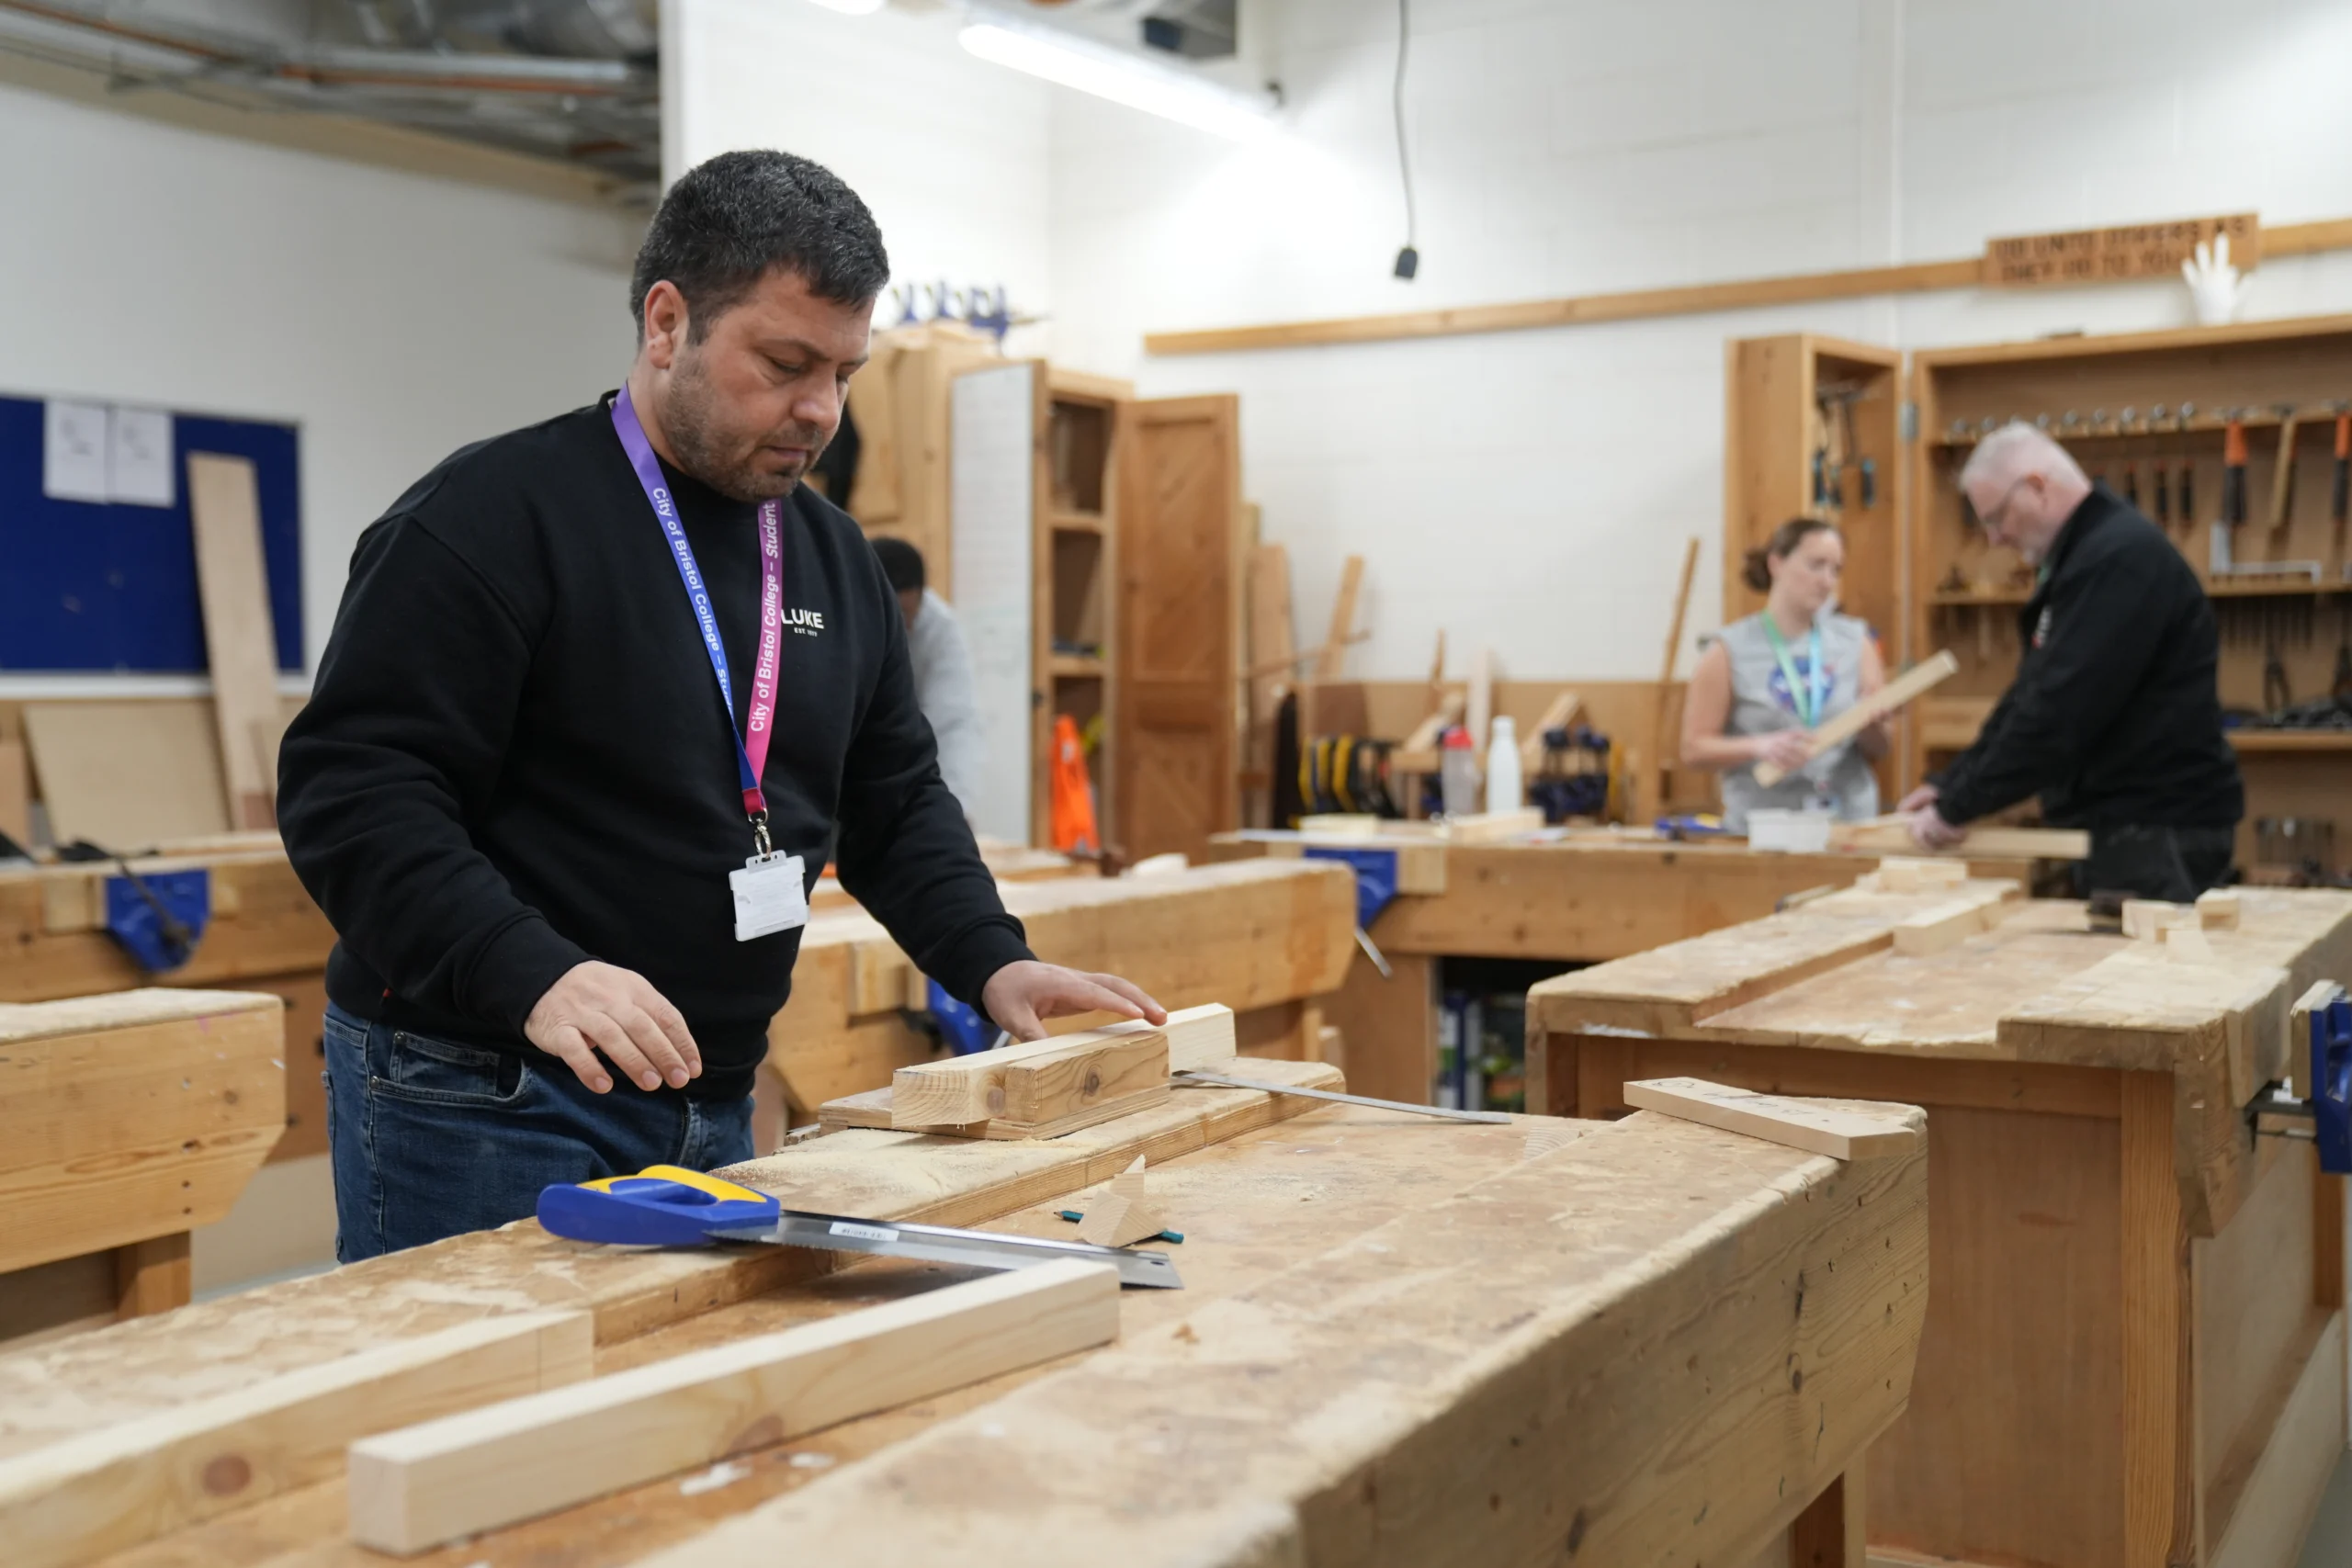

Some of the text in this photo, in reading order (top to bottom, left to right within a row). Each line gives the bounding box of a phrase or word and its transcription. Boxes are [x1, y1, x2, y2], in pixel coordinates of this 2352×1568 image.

[653, 488, 673, 517] City
[667, 521, 682, 536] of
[763, 503, 778, 558] Student
[674, 539, 702, 590] Bristol
[764, 574, 778, 626] College
[781, 608, 824, 628] LUKE
[695, 594, 719, 651] College
[759, 629, 775, 679] Bristol
[759, 682, 770, 698] of
[751, 702, 770, 731] City
